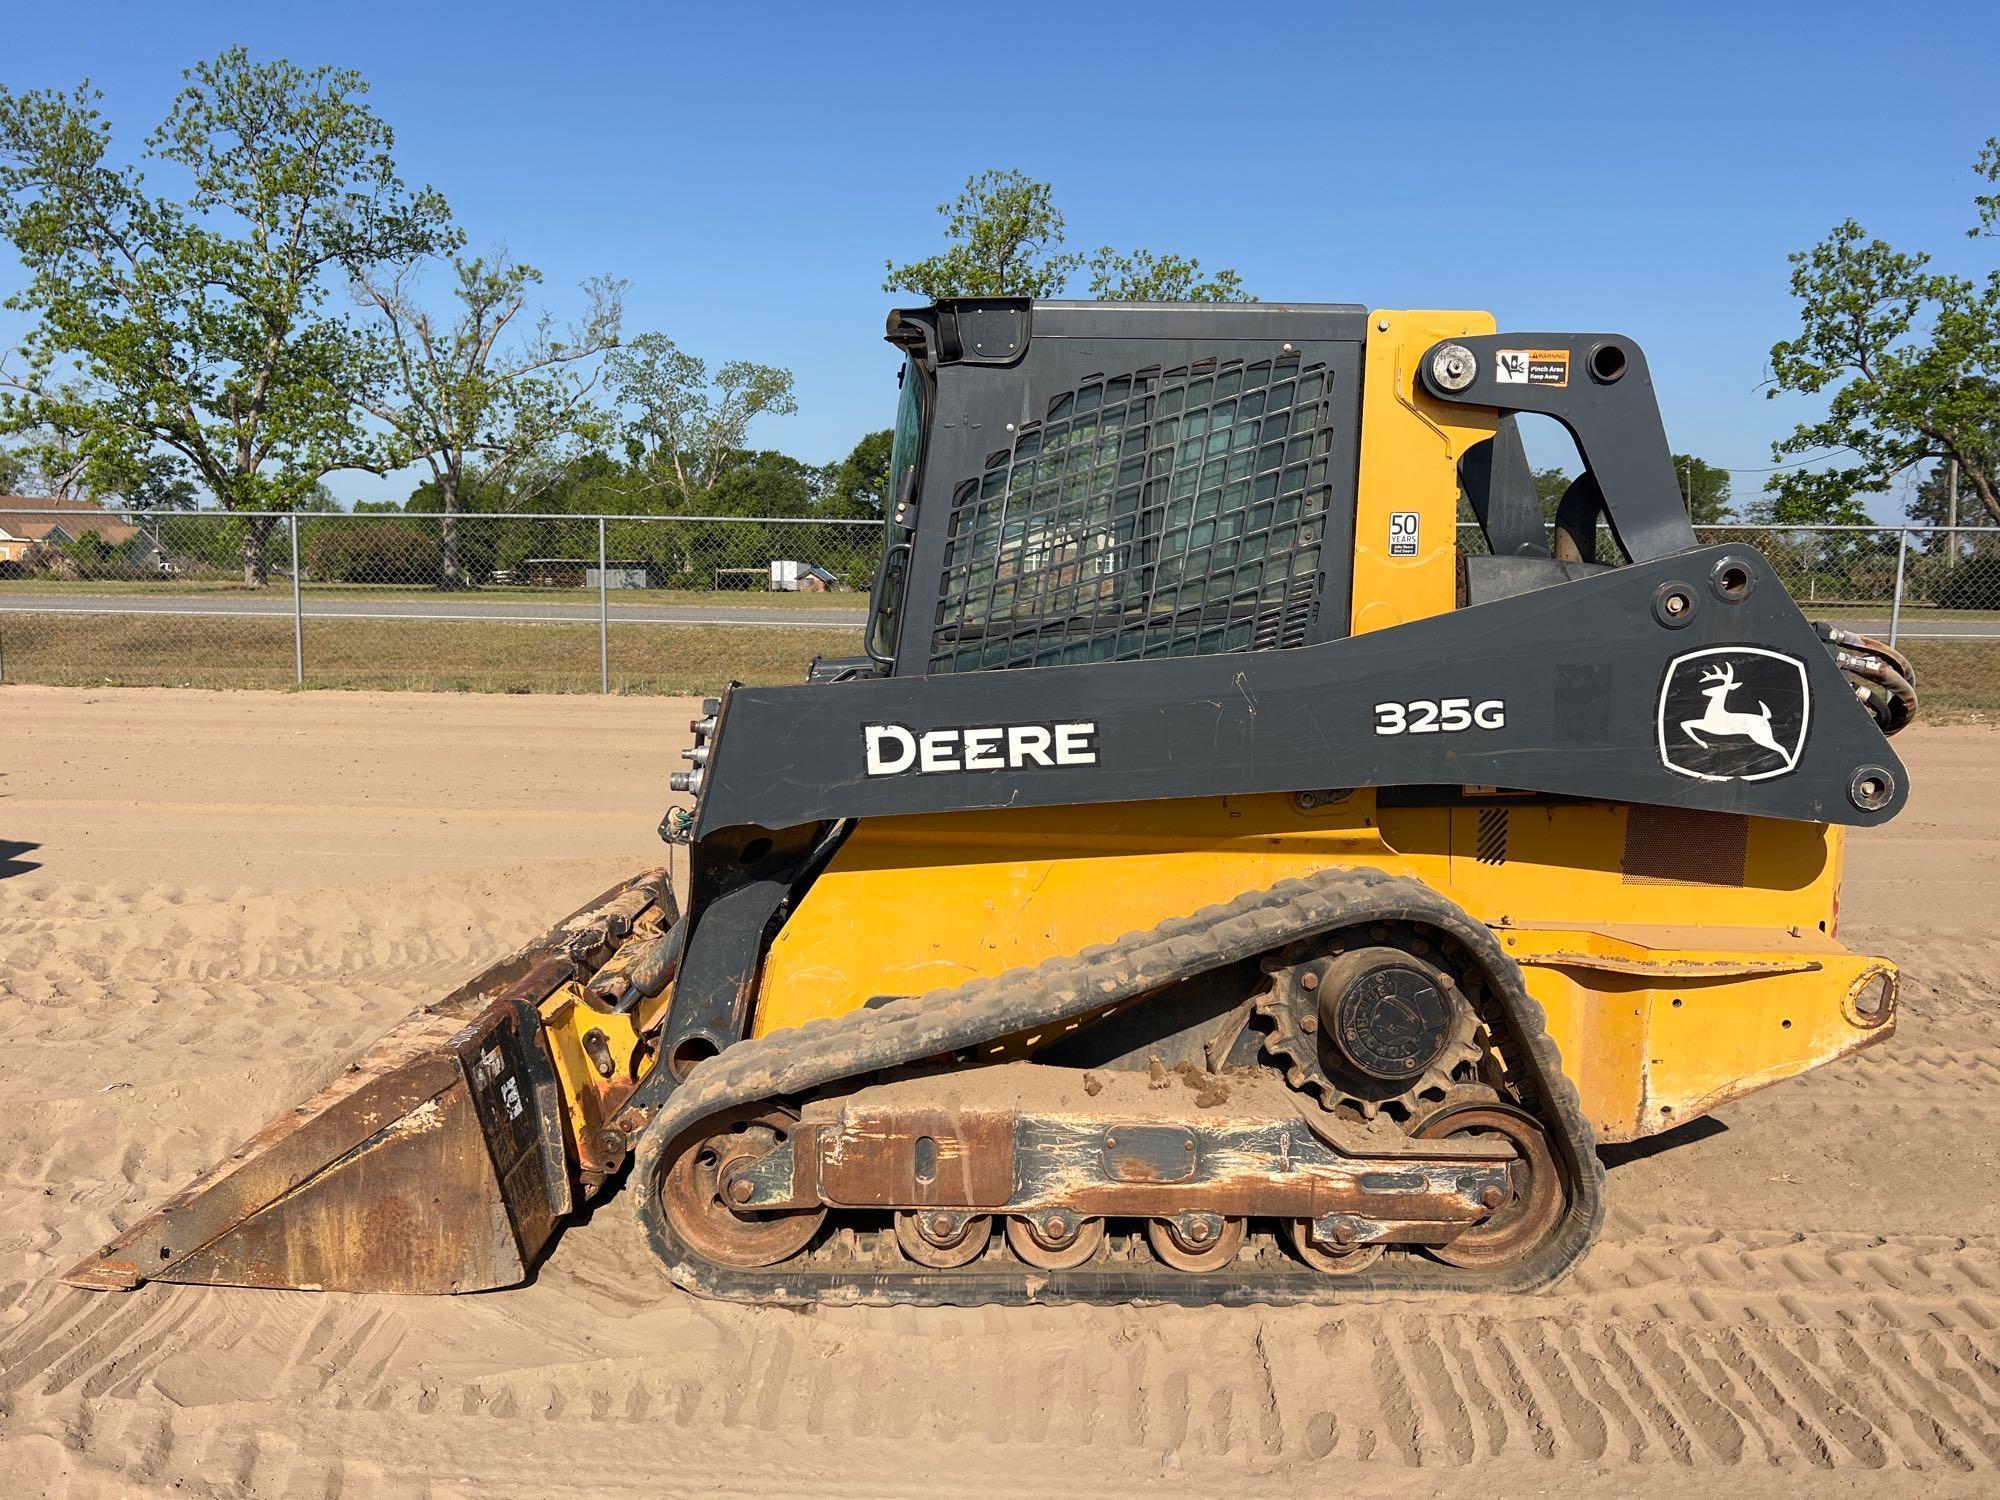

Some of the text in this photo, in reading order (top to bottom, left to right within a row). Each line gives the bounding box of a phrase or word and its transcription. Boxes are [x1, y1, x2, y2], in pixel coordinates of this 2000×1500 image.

[1391, 515, 1417, 535] 50
[1375, 698, 1505, 735] 325G
[865, 722, 1096, 775] DEERE
